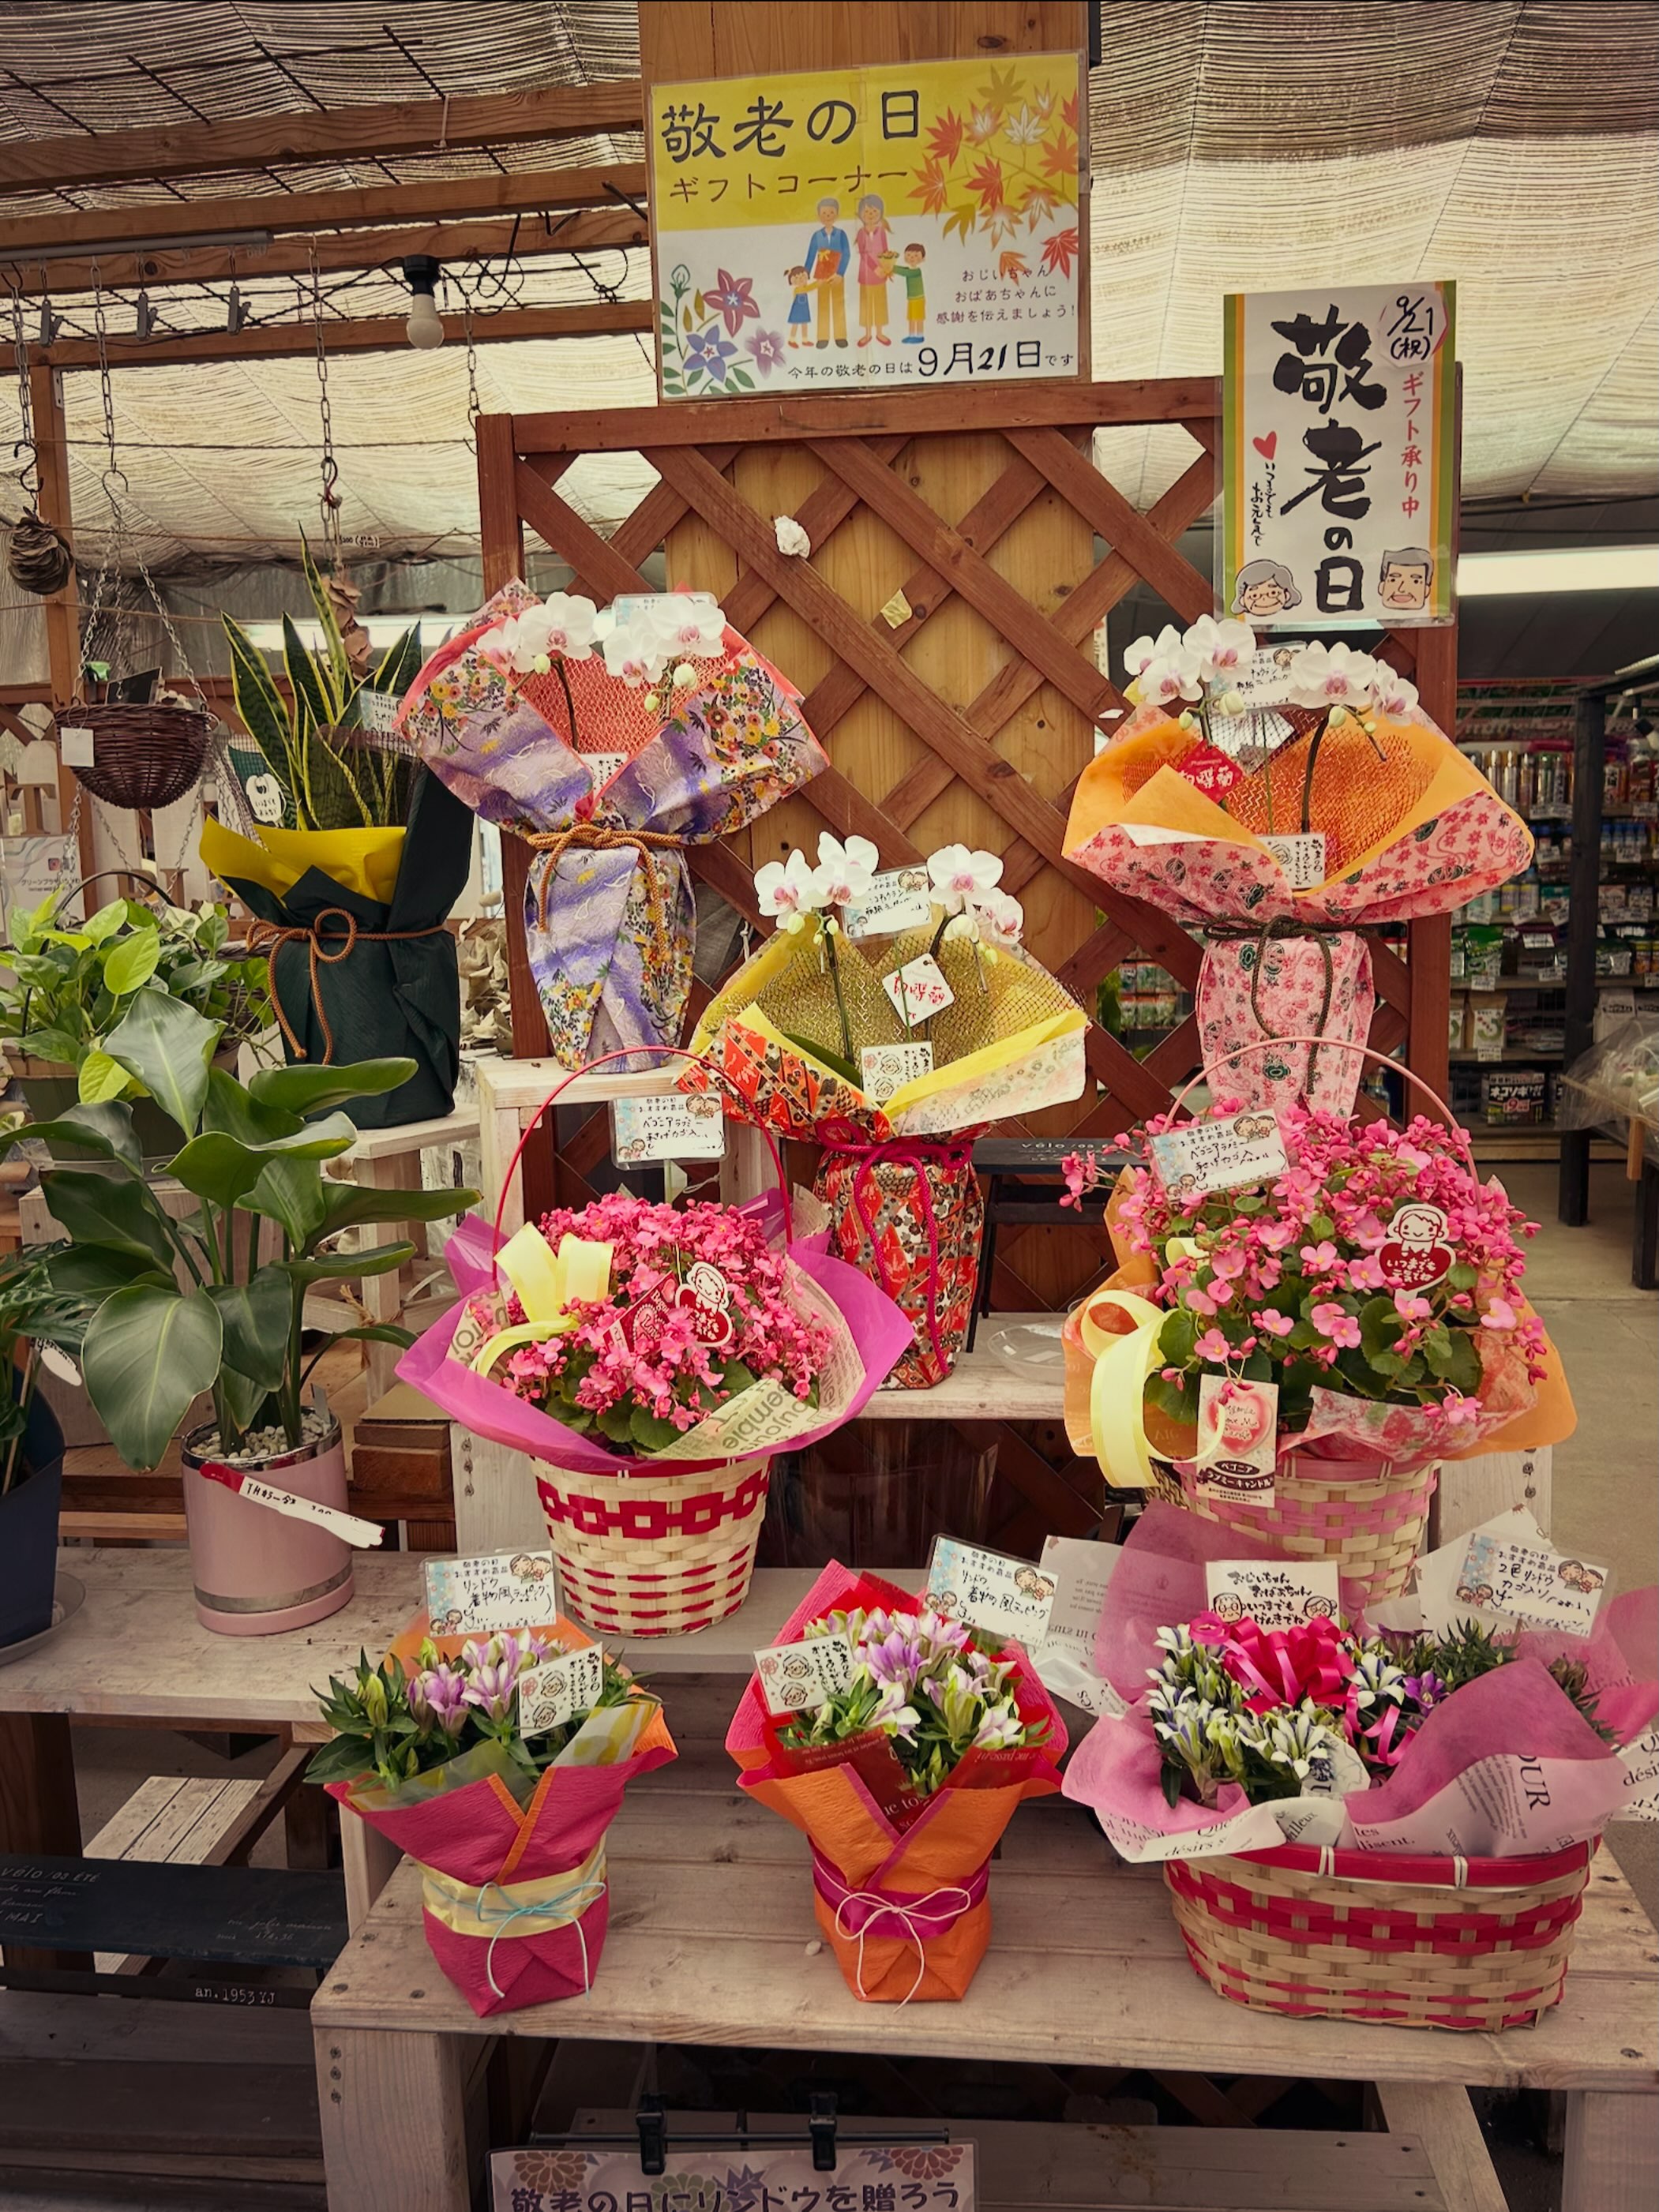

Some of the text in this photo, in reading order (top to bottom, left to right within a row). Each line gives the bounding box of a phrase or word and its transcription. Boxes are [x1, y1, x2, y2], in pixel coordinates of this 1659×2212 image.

[662, 89, 920, 163] 敬老の日
[670, 167, 909, 203] ギフトコーナー
[962, 265, 1050, 283] おじいちゃん
[955, 284, 1057, 302] おばあちゃんに
[1401, 373, 1424, 519] ギフト承り中
[1271, 304, 1387, 614] 敬老の日
[1387, 1257, 1437, 1272] いつまでも
[1221, 1463, 1253, 1474] ベゴニア
[1227, 1570, 1290, 1585] おじいちゃん
[1249, 1585, 1312, 1598] おばあちゃん
[1248, 1599, 1295, 1612] いつまでも
[1254, 1613, 1305, 1625] げんきでね
[1165, 1842, 1213, 1858] désirs
[511, 2181, 959, 2212] 敬老の日にリンドウを贈ろう
